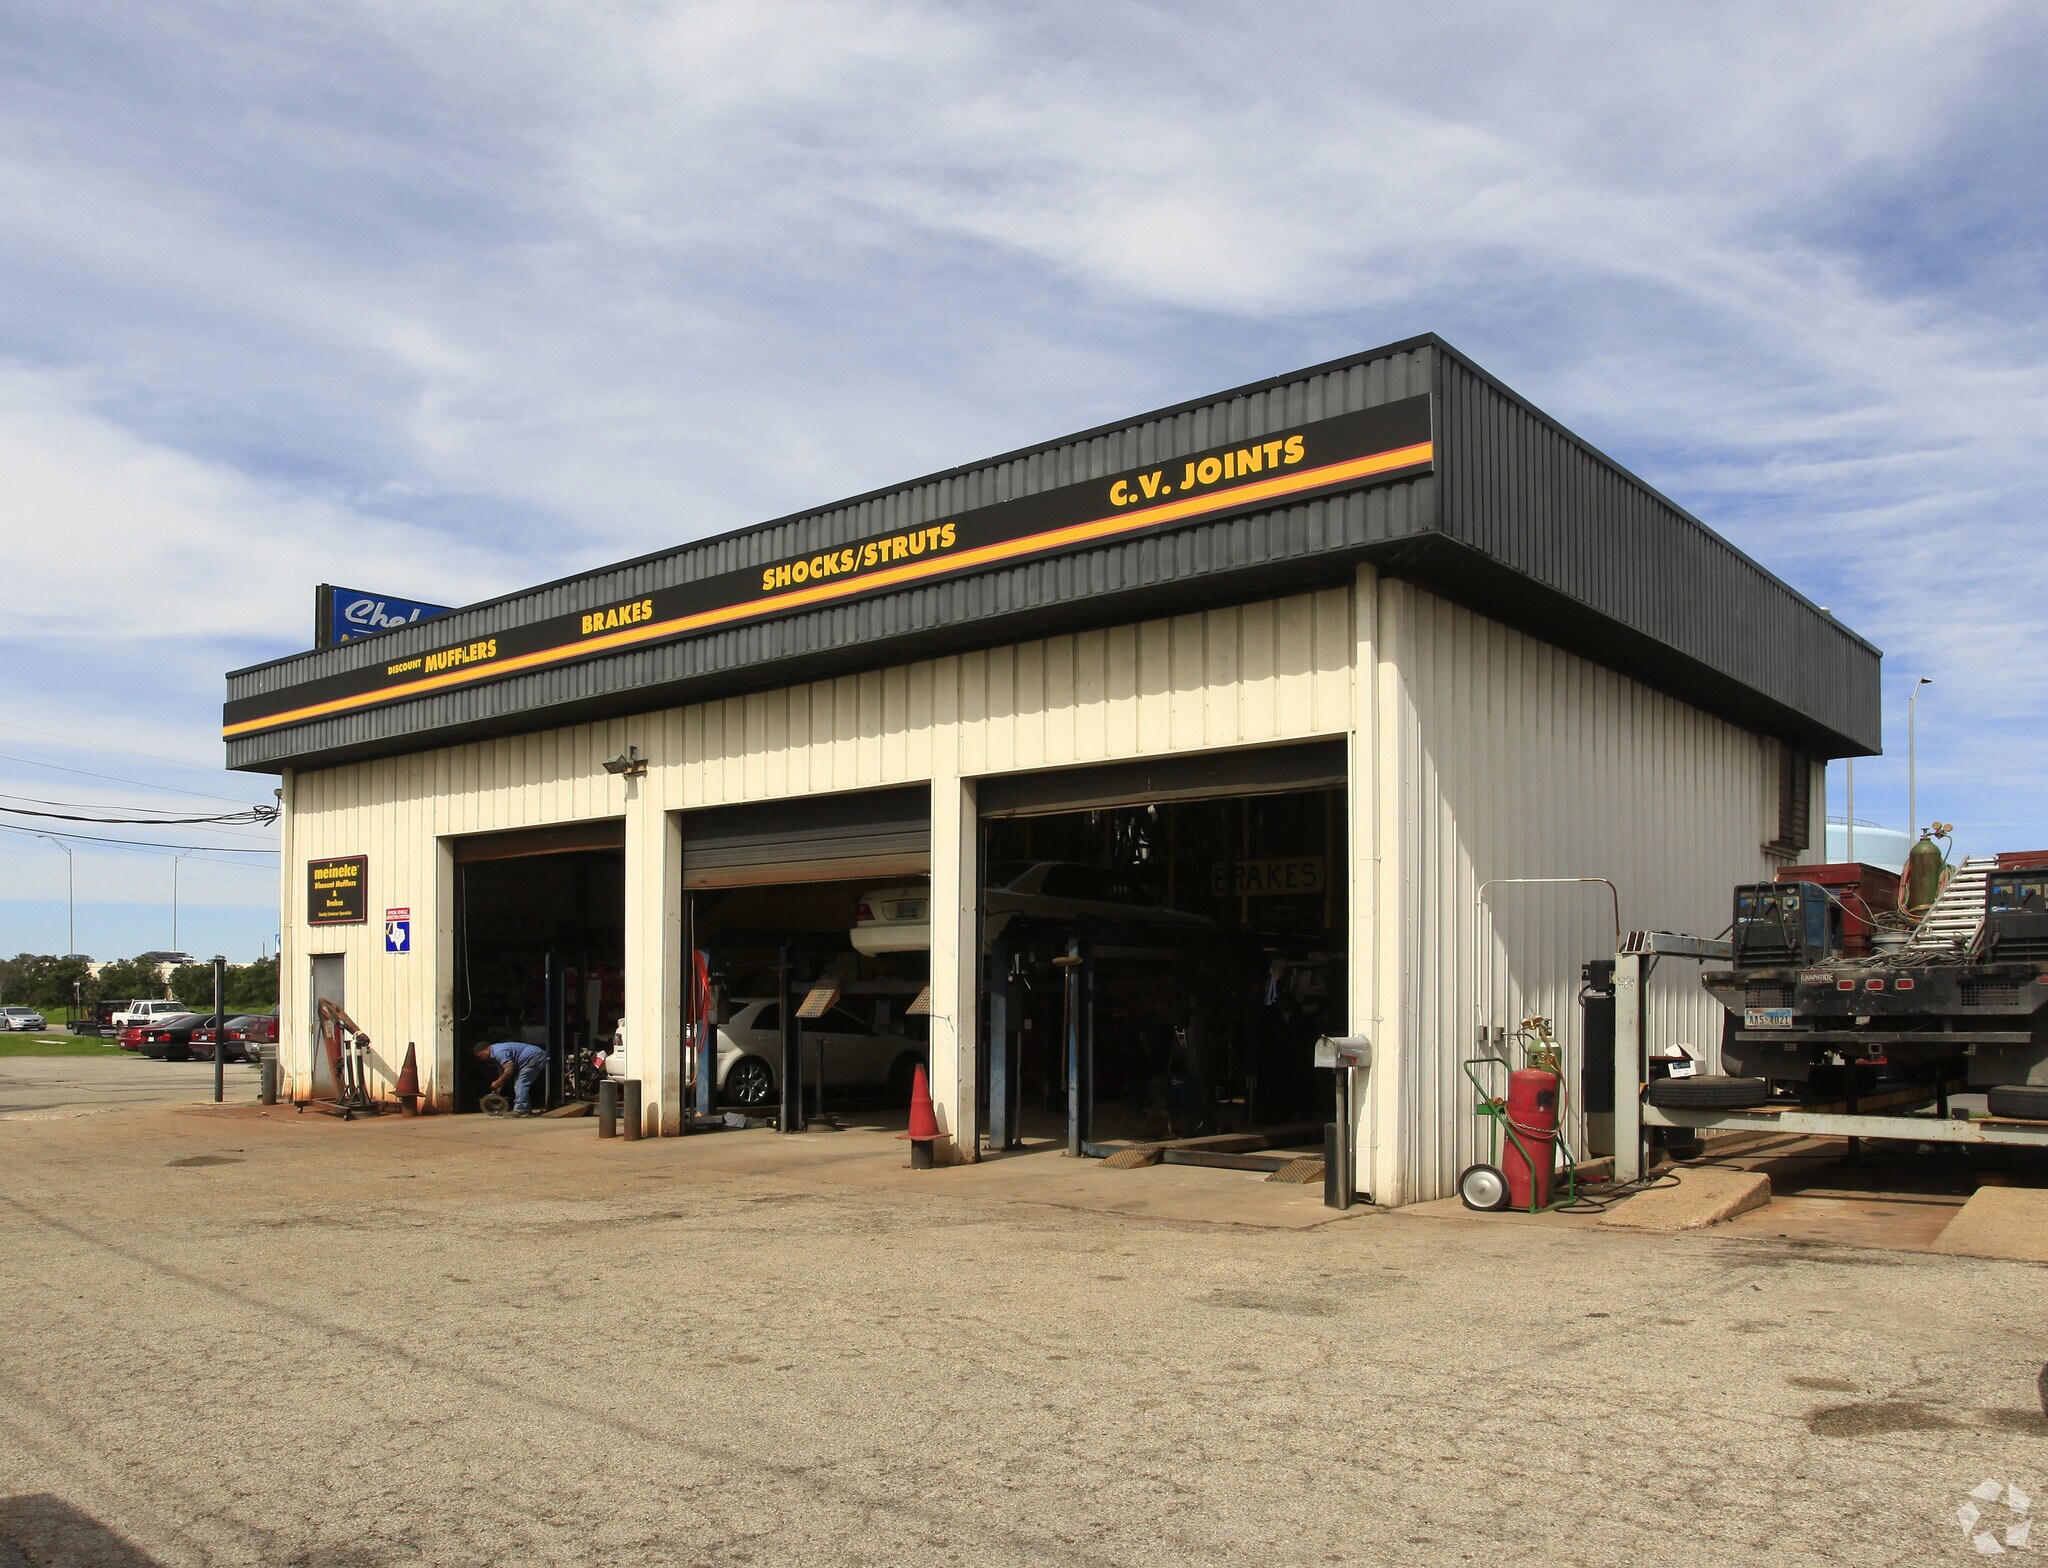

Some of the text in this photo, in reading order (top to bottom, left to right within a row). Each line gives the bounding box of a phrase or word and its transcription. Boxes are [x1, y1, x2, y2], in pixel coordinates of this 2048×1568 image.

[1110, 435, 1305, 506] C.V. JOINTS
[762, 523, 957, 591] SHOCKS/STRUTS
[582, 600, 653, 635] BRAKES
[387, 638, 497, 676] DISCOUNT MUFFLERS
[1213, 862, 1318, 893] BRAKES
